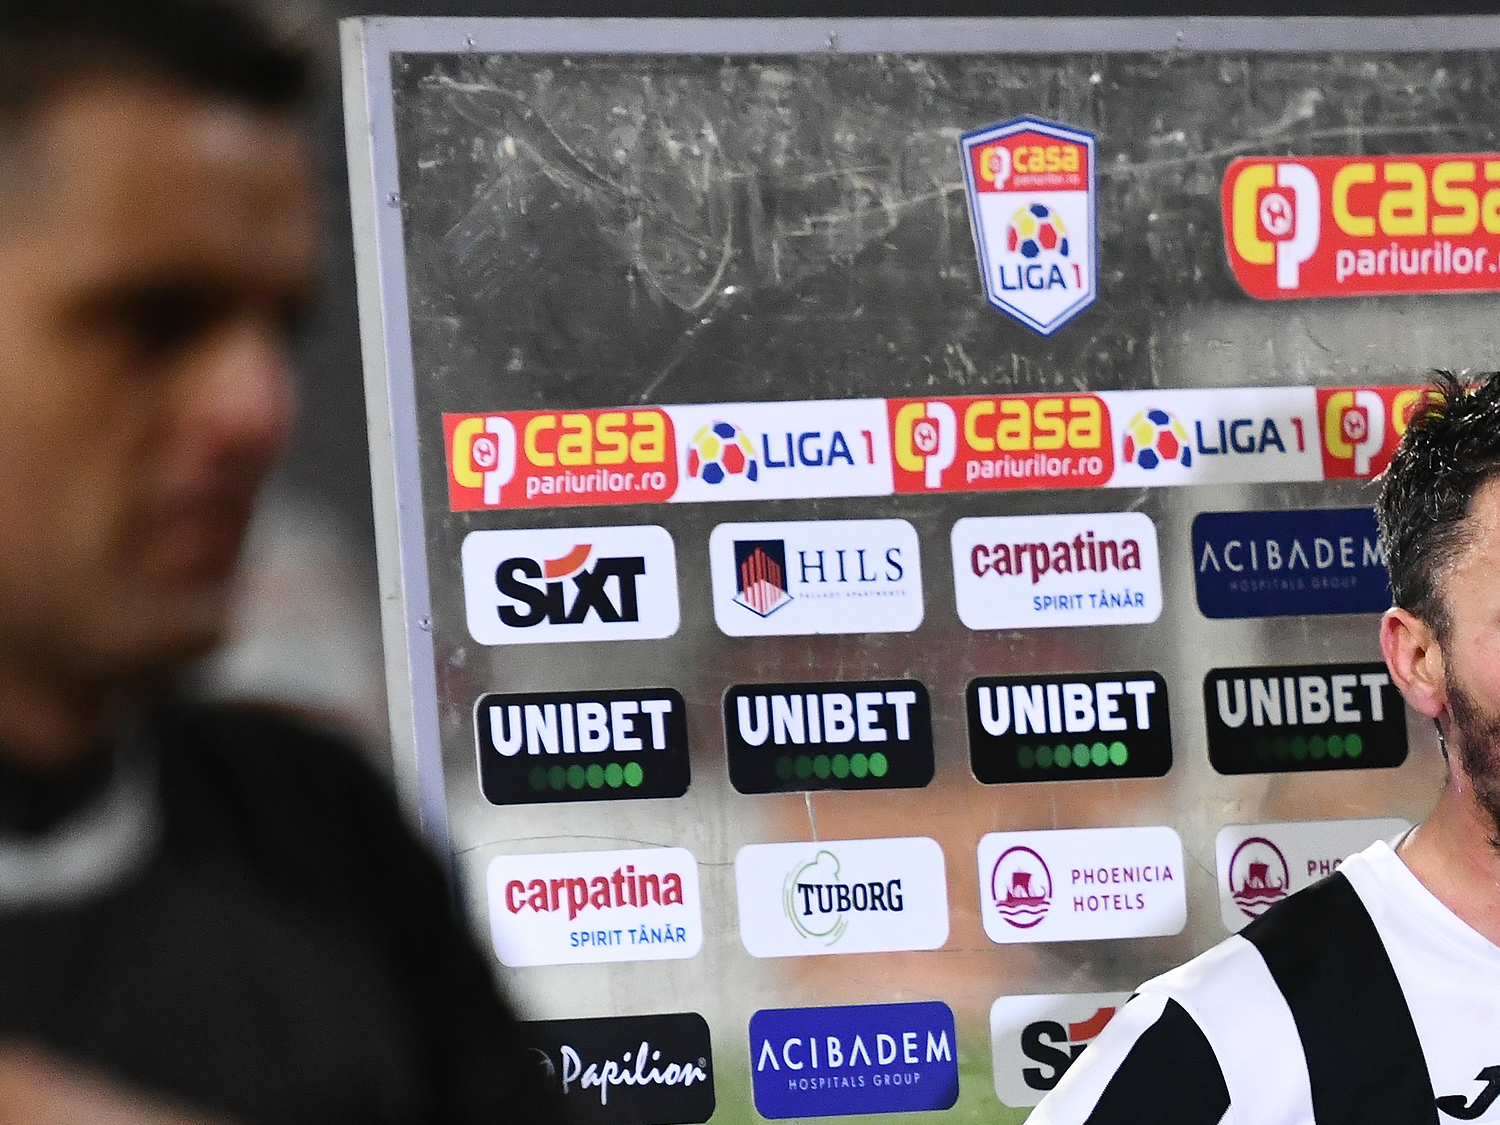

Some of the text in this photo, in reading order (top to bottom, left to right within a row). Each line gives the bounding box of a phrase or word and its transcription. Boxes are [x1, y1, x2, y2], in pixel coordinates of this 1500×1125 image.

[1013, 146, 1080, 173] casa
[999, 264, 1082, 290] LIGA 1
[524, 411, 665, 467] casa
[964, 399, 1102, 452] casa
[1195, 417, 1306, 455] LIGA 1
[762, 430, 875, 468] LIGA 1
[526, 469, 667, 500] pariurilor.ro
[966, 453, 1104, 484] pariurilor.ro
[797, 547, 904, 583] HILS
[971, 531, 1142, 584] carpatina
[1200, 536, 1385, 573] ACIBADEM
[1032, 587, 1146, 613] SPIRIT TÂNĂR
[736, 690, 917, 747] UNIBET
[978, 680, 1156, 738] UNIBET
[1216, 672, 1392, 729] UNIBET
[489, 700, 672, 757] UNIBET
[504, 864, 684, 921] carpatina
[1070, 865, 1174, 886] PHOENICIA
[798, 878, 903, 917] TUBORG
[1073, 891, 1146, 913] HOTELS
[570, 922, 687, 948] SPIRIT TÂNĂR
[756, 1028, 952, 1072] ACIBADEM
[561, 1042, 706, 1106] Papilion
[788, 1071, 921, 1092] HOSPITALS GROUP
